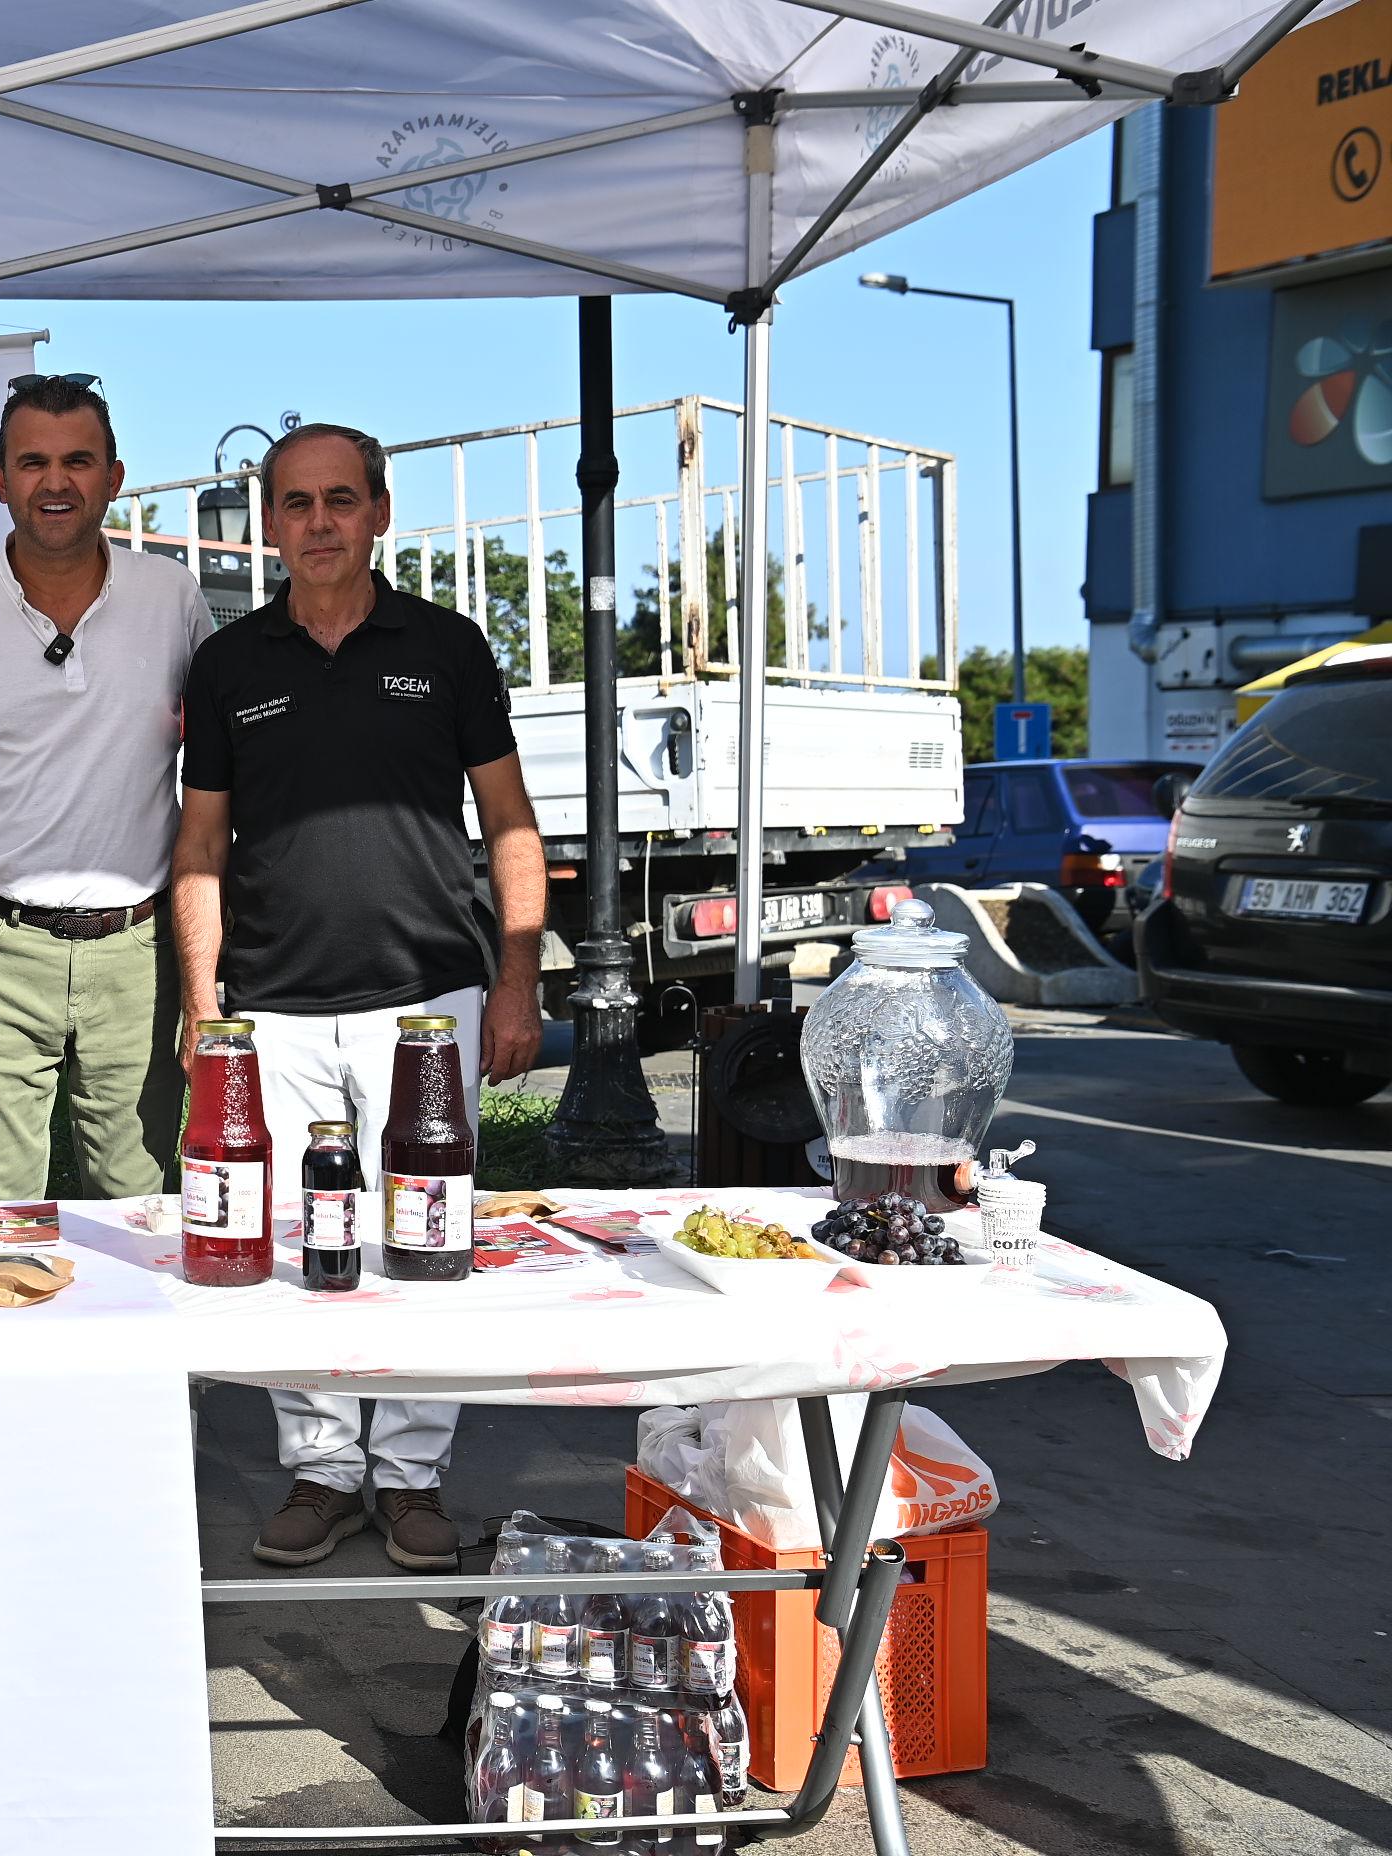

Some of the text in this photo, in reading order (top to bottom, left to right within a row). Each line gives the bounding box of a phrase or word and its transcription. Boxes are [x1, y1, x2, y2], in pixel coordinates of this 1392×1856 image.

[1317, 58, 1392, 107] REKL
[382, 675, 431, 694] TAGEM
[1252, 881, 1275, 908] 59
[1325, 885, 1365, 914] 362
